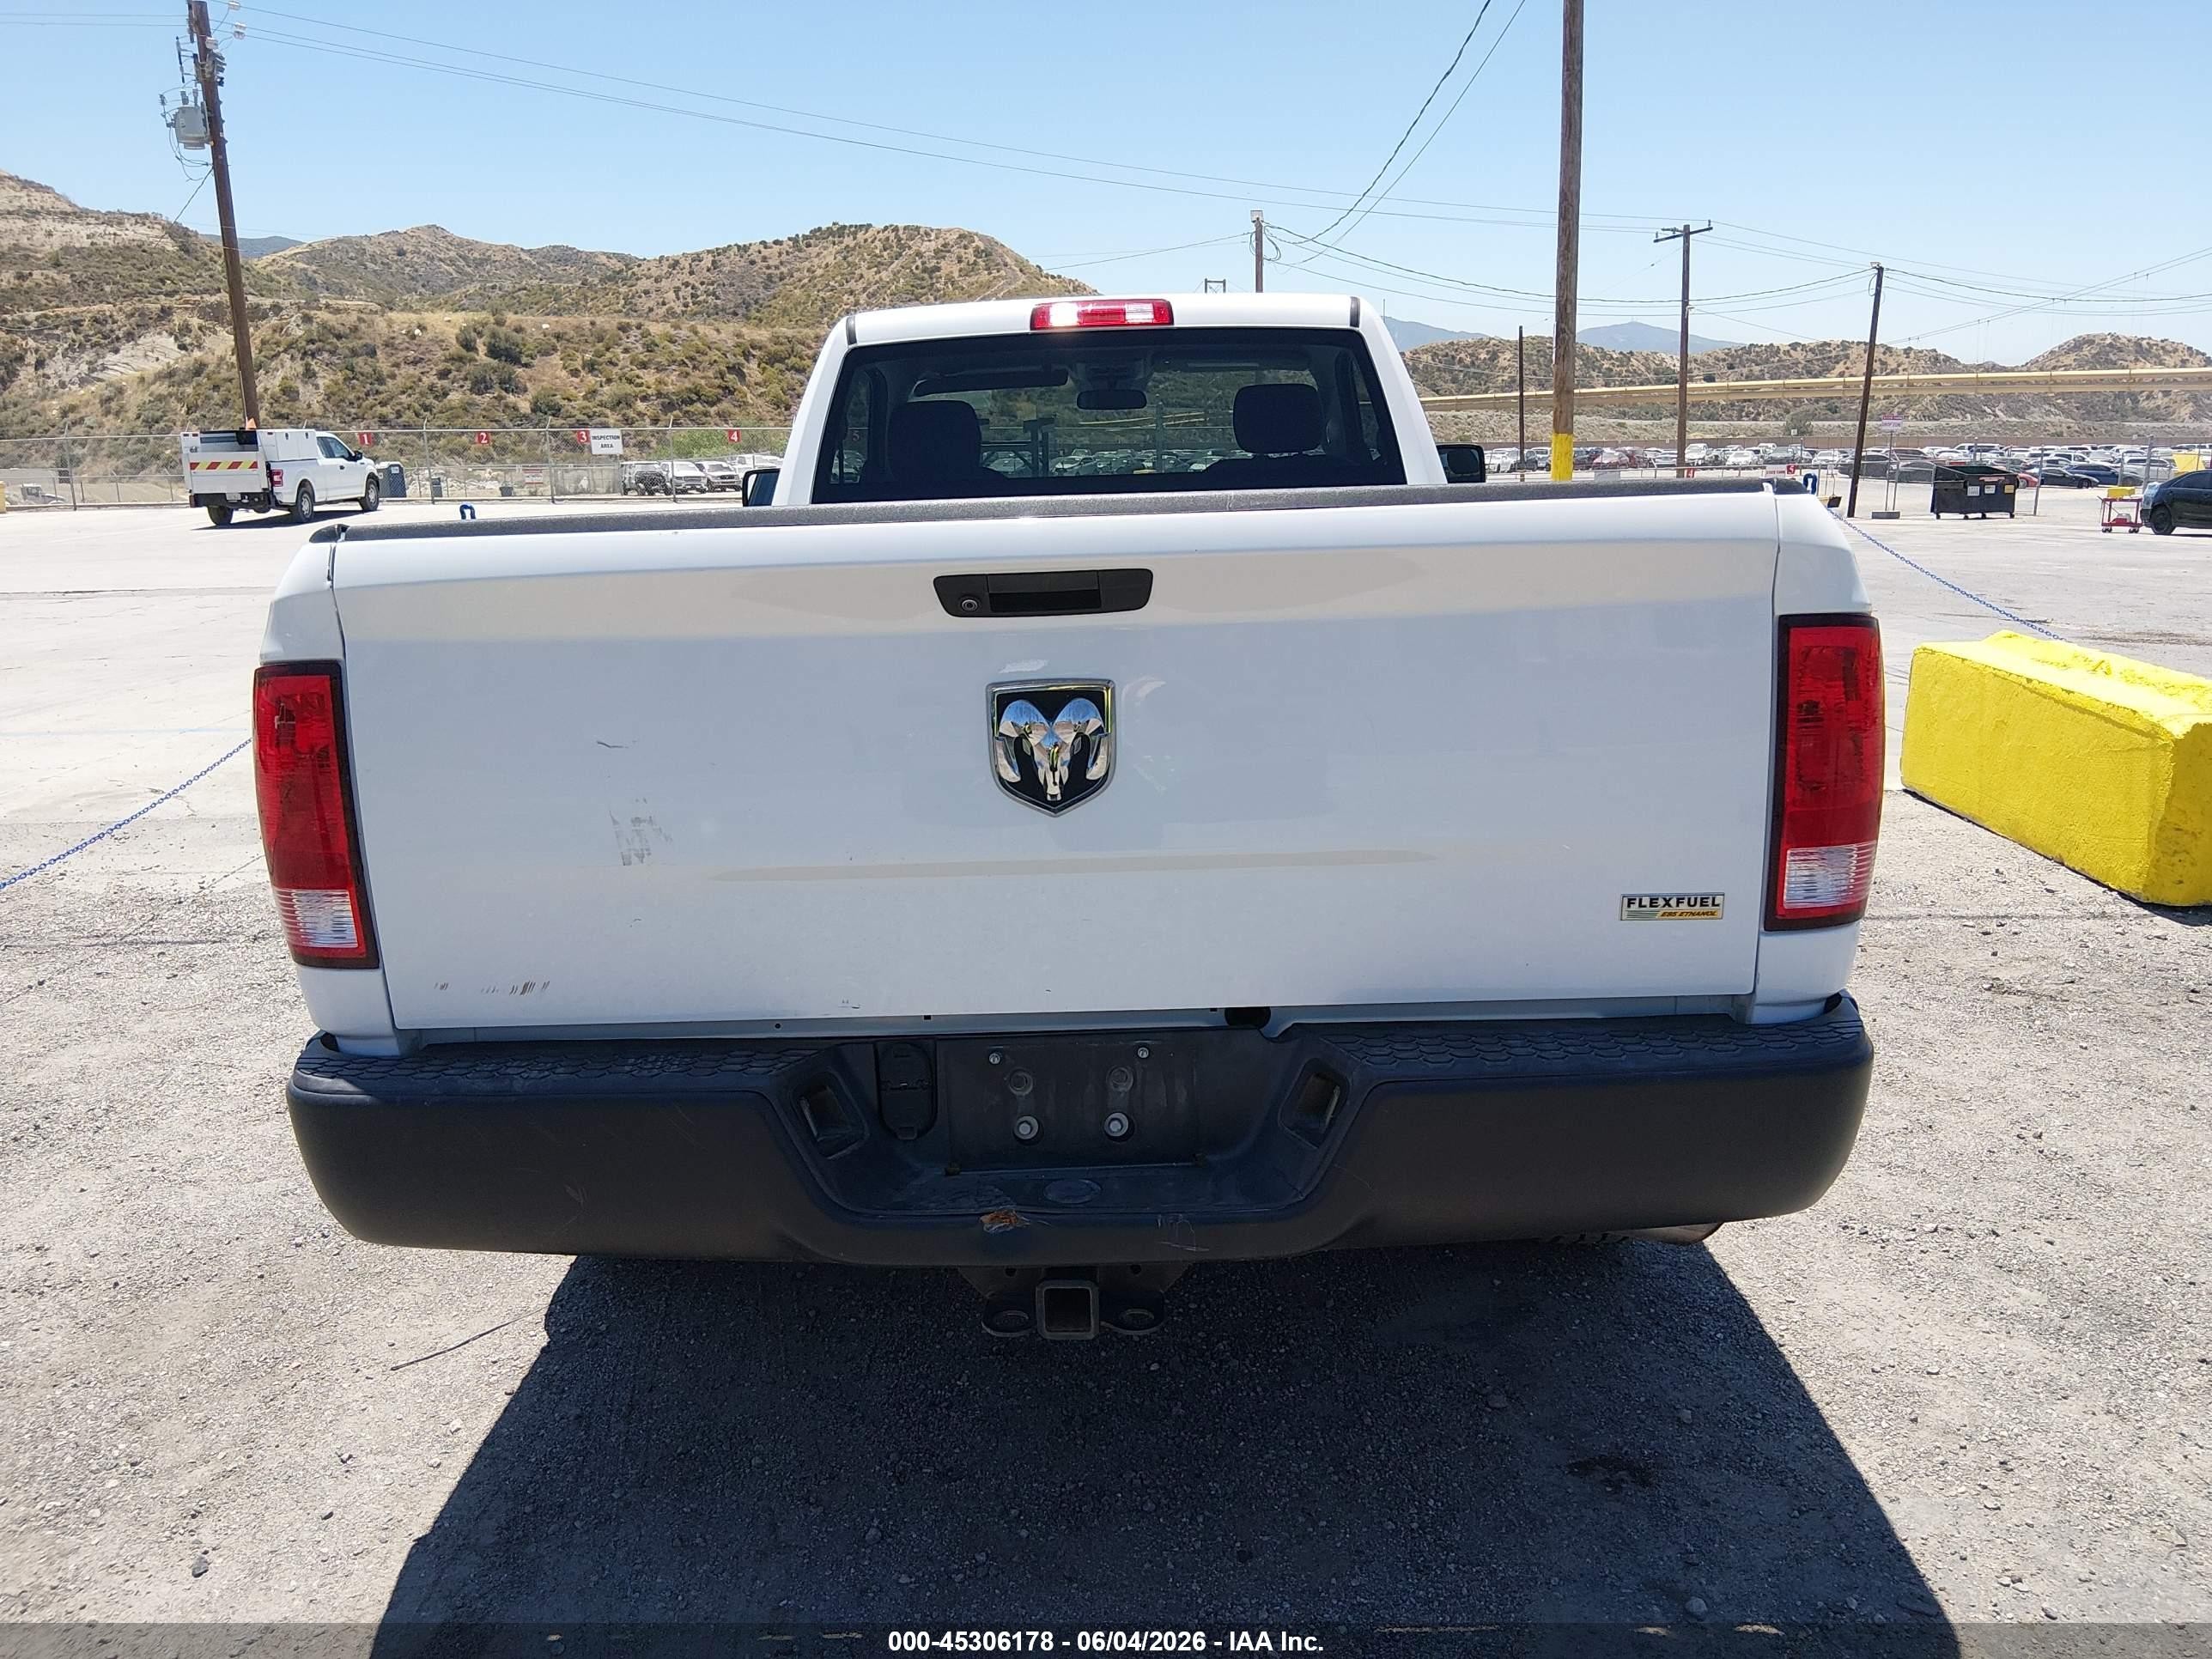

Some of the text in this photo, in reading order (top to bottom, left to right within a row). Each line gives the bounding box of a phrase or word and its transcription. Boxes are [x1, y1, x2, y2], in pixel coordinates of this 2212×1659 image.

[362, 434, 370, 445] 1
[480, 432, 488, 444] 2
[580, 431, 587, 442] 3
[730, 430, 738, 442] 4
[1626, 896, 1721, 908] FLEXFUEL
